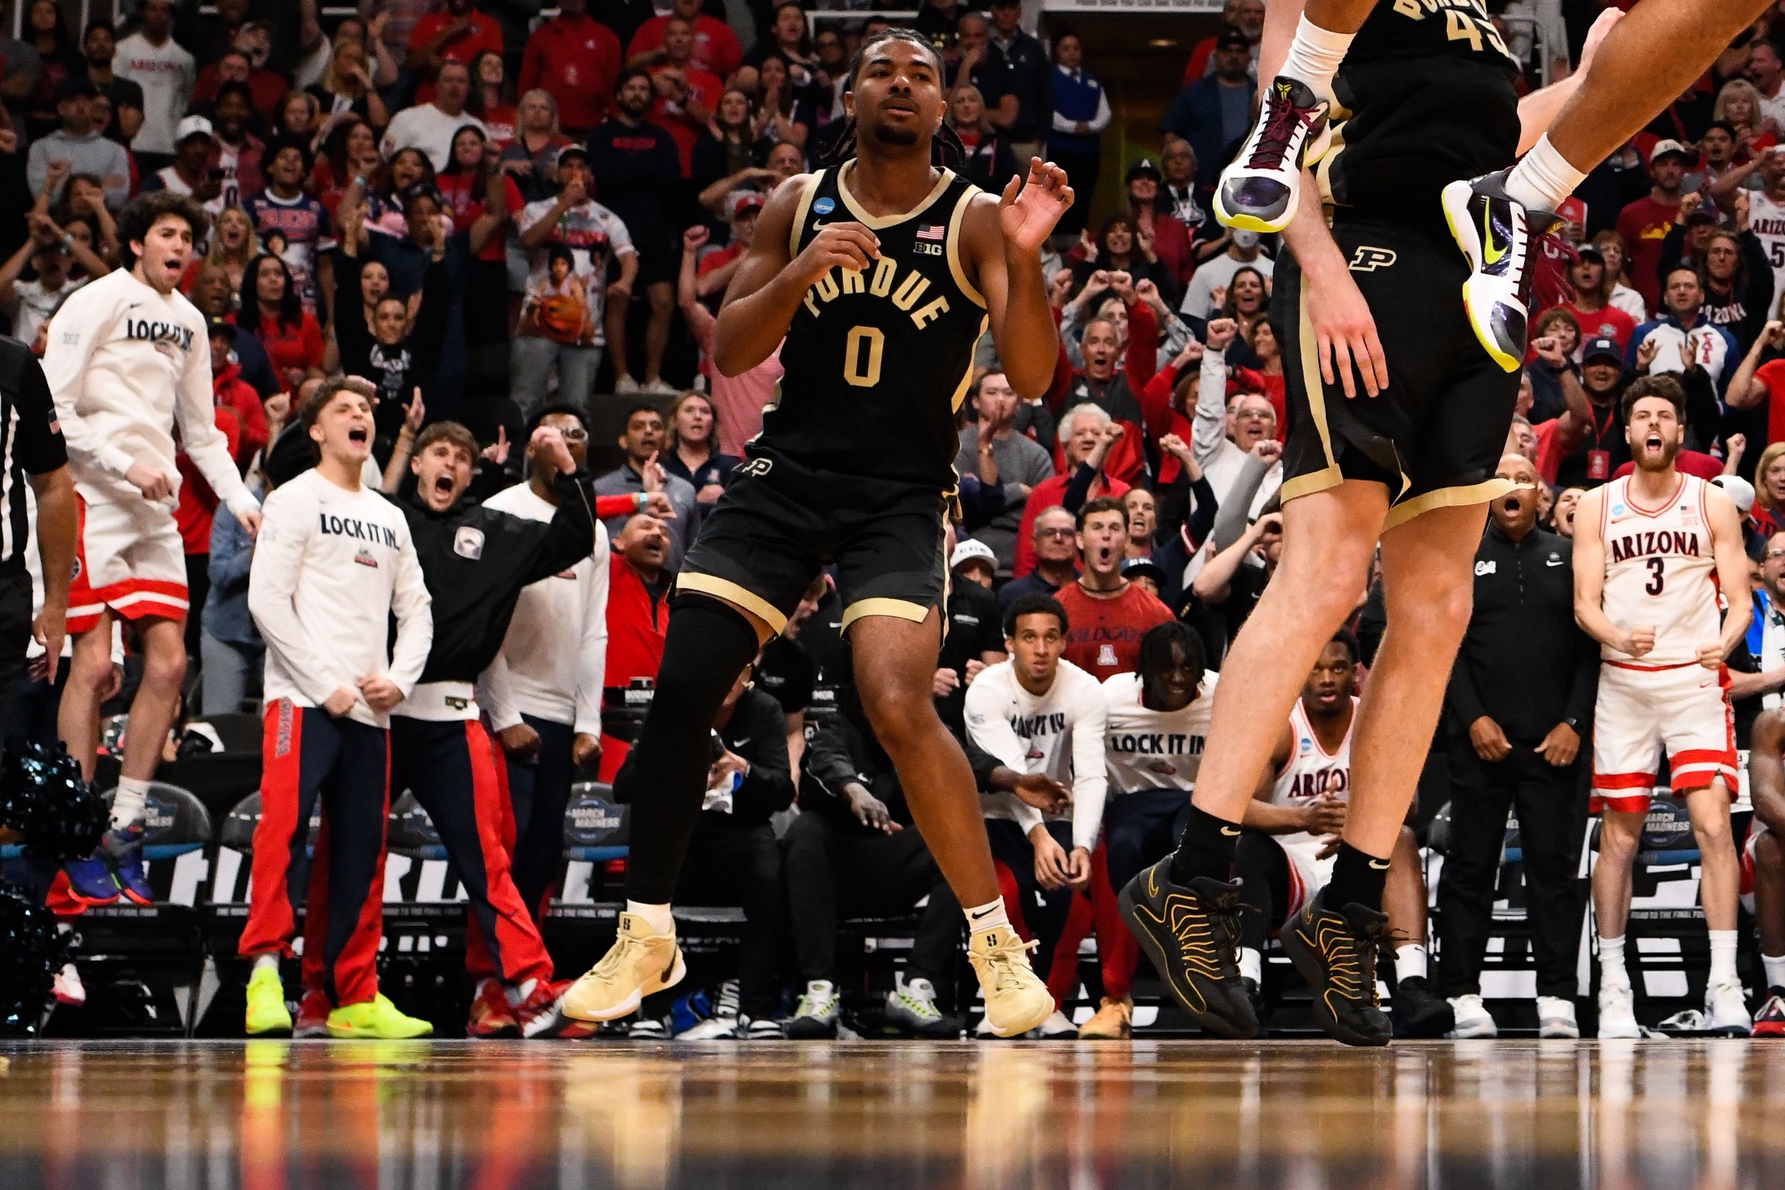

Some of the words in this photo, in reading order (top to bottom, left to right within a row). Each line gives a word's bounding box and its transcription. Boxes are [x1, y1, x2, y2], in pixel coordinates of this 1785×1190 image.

[1348, 245, 1398, 273] P
[843, 324, 885, 388] 0
[320, 512, 366, 542] LOCK
[367, 521, 381, 544] IT
[1610, 530, 1700, 564] ARIZONA
[1644, 556, 1665, 596] 3
[1111, 733, 1164, 755] LOCK
[1168, 733, 1187, 755] IT
